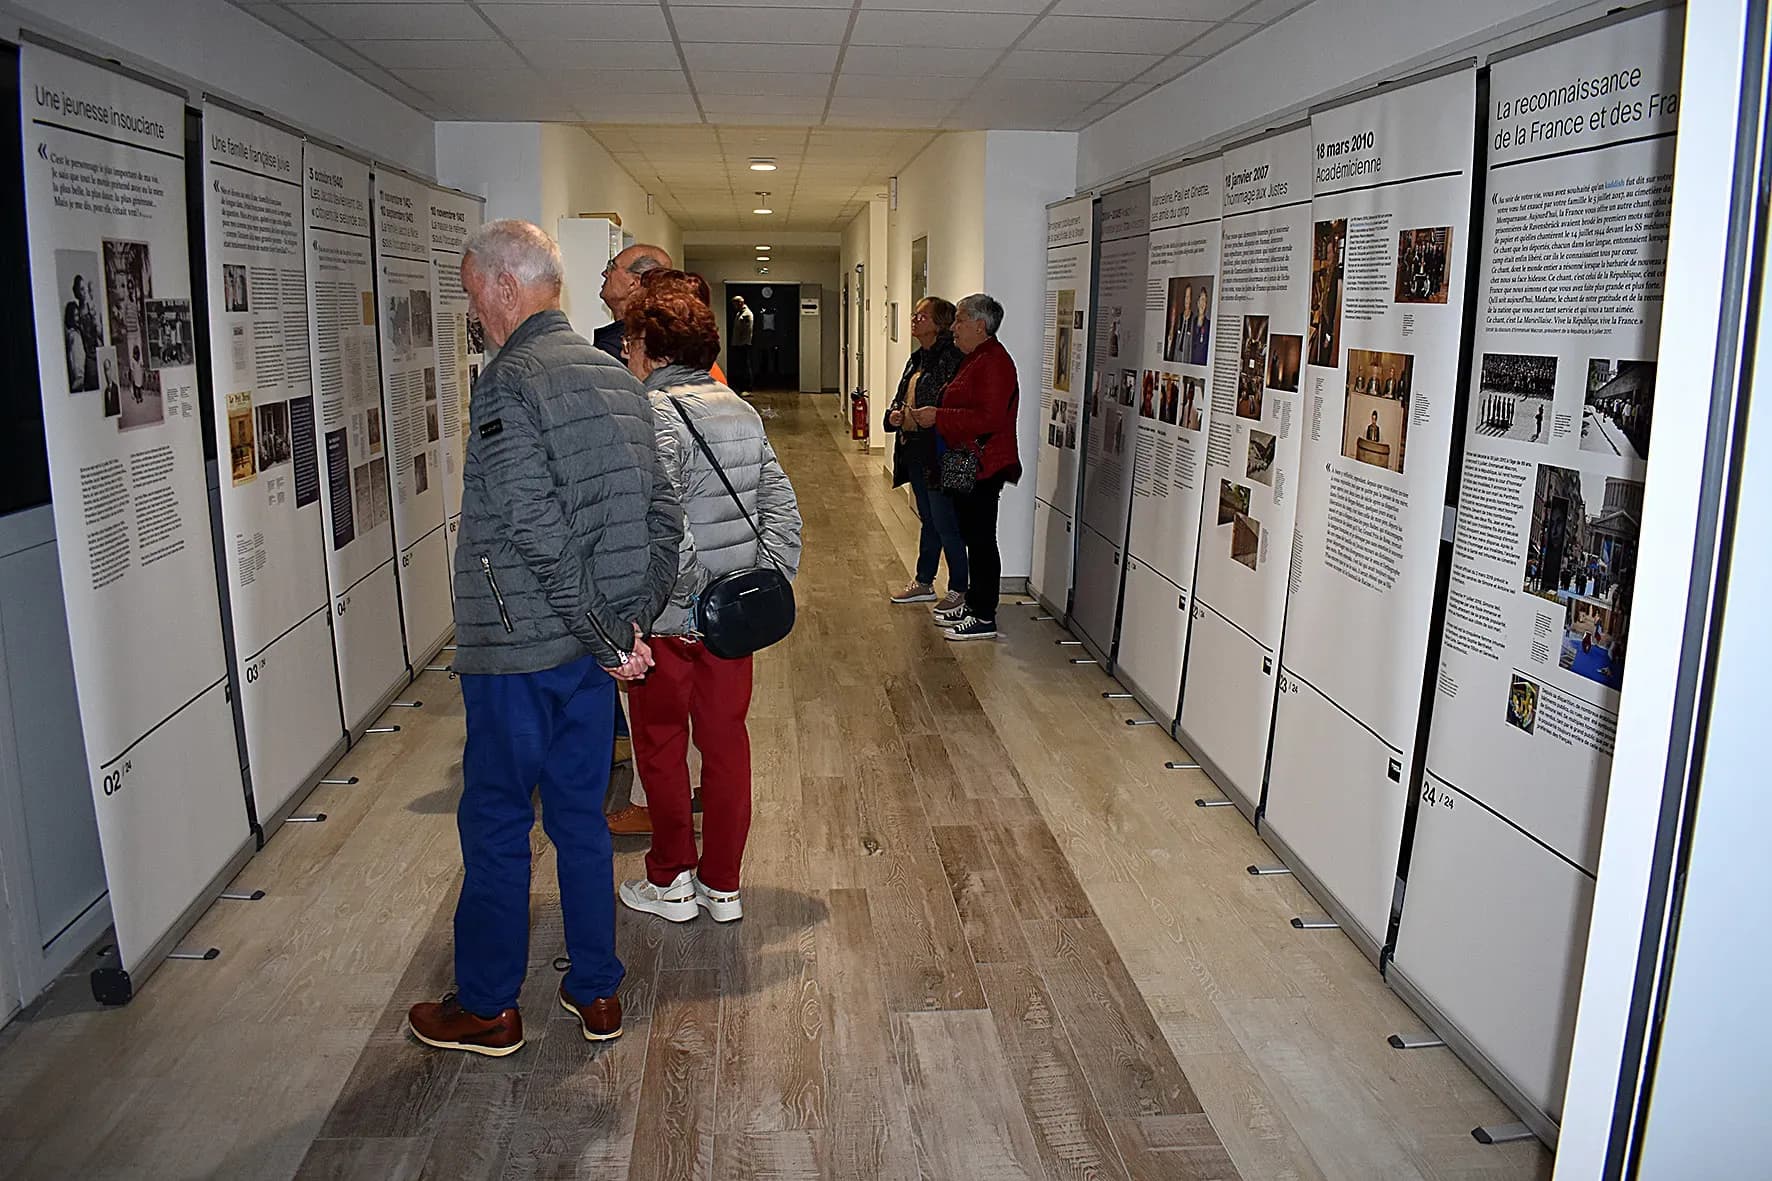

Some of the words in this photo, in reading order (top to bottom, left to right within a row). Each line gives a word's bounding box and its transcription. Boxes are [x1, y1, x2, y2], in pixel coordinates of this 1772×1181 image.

[1496, 100, 1510, 120] La
[1514, 68, 1641, 116] reconnaissance
[36, 85, 60, 110] Une
[62, 92, 108, 124] jeunesse
[110, 106, 164, 139] insouciante
[1494, 129, 1510, 150] de
[1514, 124, 1525, 146] la
[1530, 115, 1584, 142] France
[1590, 106, 1605, 130] et
[1610, 101, 1643, 126] des
[1648, 93, 1678, 118] Fra
[212, 134, 226, 153] Une
[1317, 143, 1325, 160] 18
[1327, 140, 1350, 157] mars
[1351, 131, 1374, 152] 2010
[309, 168, 313, 180] 3
[1316, 157, 1381, 182] Académicienne
[1231, 169, 1252, 190] janvier
[1253, 165, 1269, 181] 2007
[1636, 176, 1645, 184] dit
[1268, 182, 1288, 197] Justes
[1635, 186, 1662, 196] cimetière
[1633, 200, 1651, 208] chant,
[1603, 214, 1626, 224] premiers
[1624, 224, 1633, 232] les
[1634, 223, 1642, 231] SS
[1613, 236, 1648, 245] entonnaient
[1610, 270, 1642, 281] République,
[1594, 283, 1604, 292] plus
[1605, 282, 1624, 292] grande
[1632, 282, 1644, 291] plus
[1629, 293, 1636, 301] de
[1615, 305, 1634, 313] aimée.
[1618, 316, 1638, 324] France.
[247, 664, 258, 683] 03
[104, 770, 121, 796] 02
[1423, 781, 1435, 807] 24
[1444, 796, 1454, 809] 24
